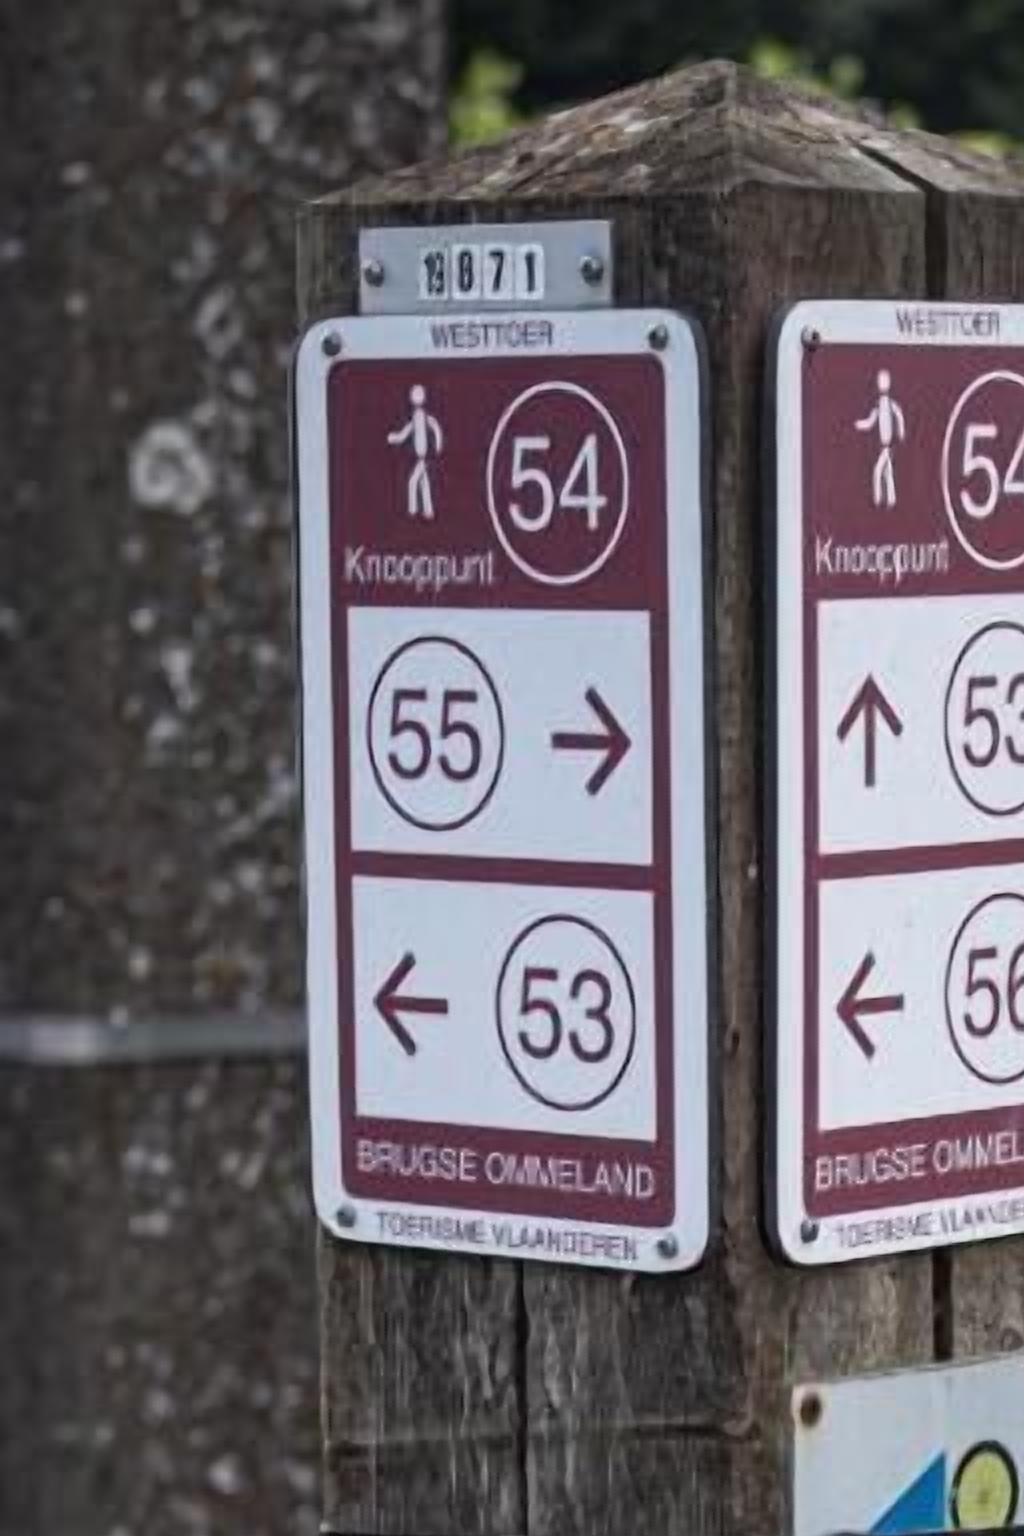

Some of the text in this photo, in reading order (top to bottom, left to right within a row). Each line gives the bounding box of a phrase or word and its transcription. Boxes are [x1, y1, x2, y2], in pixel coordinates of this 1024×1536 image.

[431, 320, 554, 348] WESTTOER
[508, 433, 608, 532] 54
[345, 545, 494, 592] Knooppunt
[816, 534, 949, 587] Knooppunt
[387, 688, 481, 782] 55
[517, 966, 615, 1064] 53
[356, 1138, 655, 1198] BRUGSE OMMELAND
[815, 1144, 927, 1190] BRUGSE
[376, 1211, 638, 1261] TOERISME VLAANDEREN
